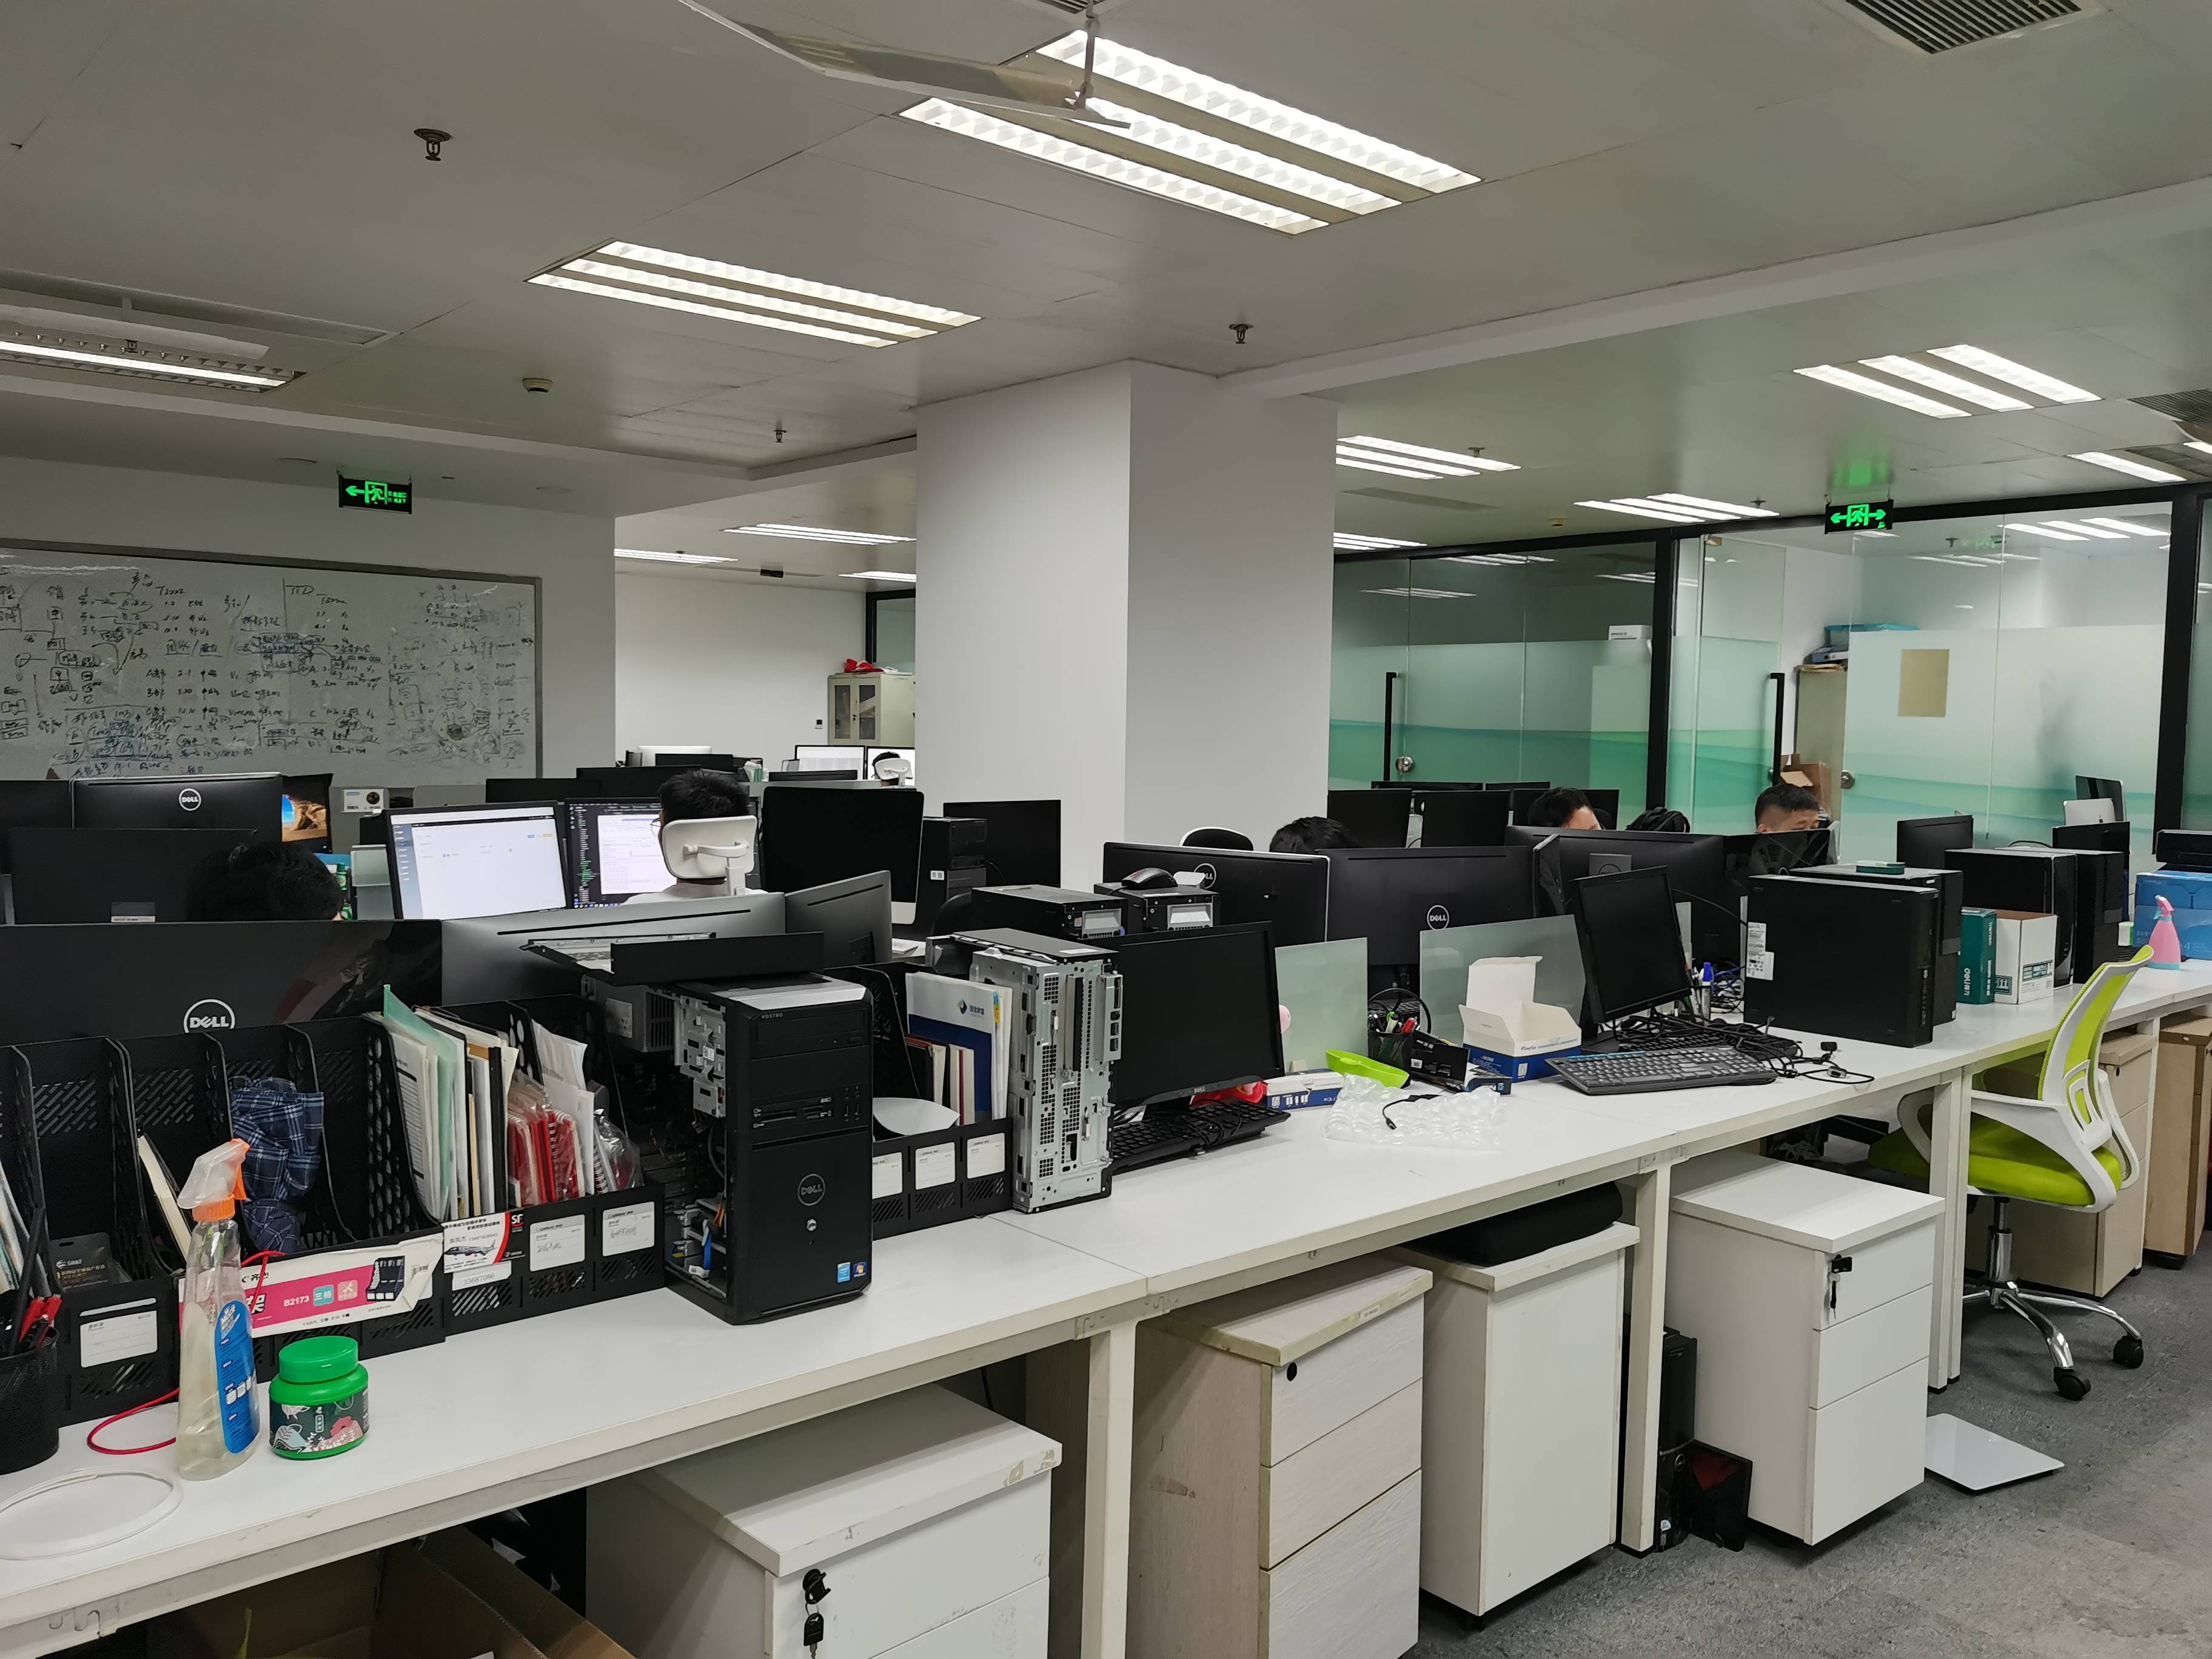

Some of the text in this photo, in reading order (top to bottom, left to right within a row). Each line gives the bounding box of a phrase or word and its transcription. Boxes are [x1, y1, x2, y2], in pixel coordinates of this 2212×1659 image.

[189, 1015, 230, 1028] DELL
[800, 1184, 822, 1195] DELL
[511, 1214, 523, 1224] SF
[283, 1295, 310, 1307] B2173
